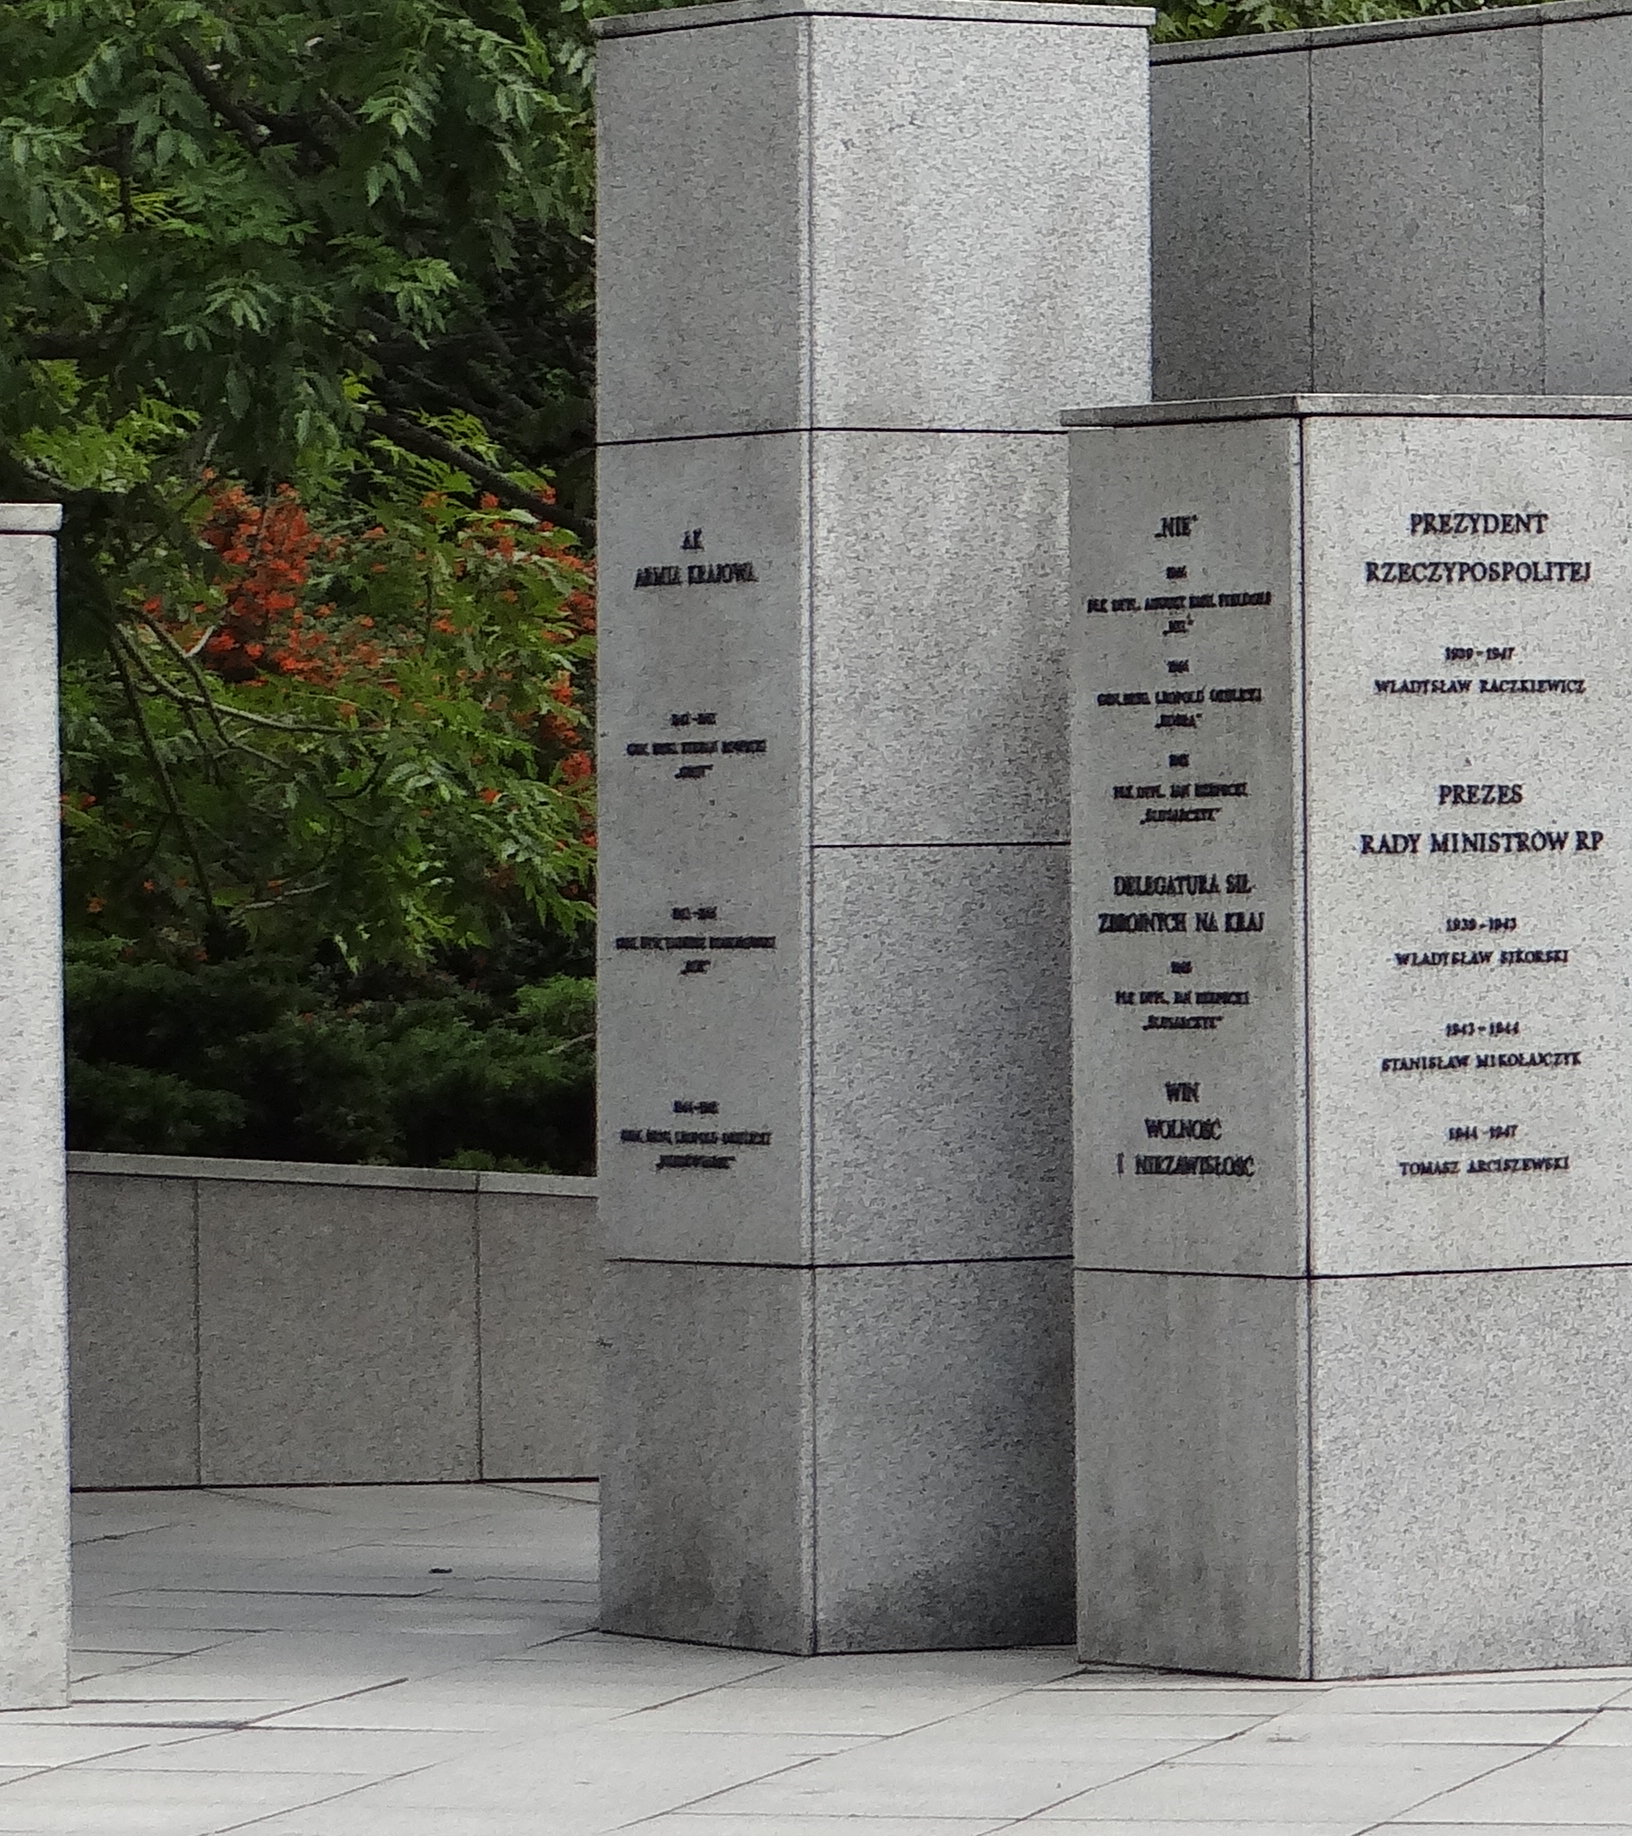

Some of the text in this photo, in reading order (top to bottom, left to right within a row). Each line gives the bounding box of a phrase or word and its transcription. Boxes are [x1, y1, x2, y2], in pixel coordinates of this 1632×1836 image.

[1410, 512, 1549, 536] PREZYDENT
[1365, 560, 1592, 584] RZECZYPOSPOLITEJ
[1373, 677, 1587, 695] WŁADYSŁAW RACZKIEWICZ
[1437, 783, 1524, 806] PREZES
[1359, 828, 1605, 856] RADY MINISTRÓW RP
[1113, 873, 1221, 897] DELEGATURA
[1394, 949, 1494, 966] WŁADYSŁAW
[1380, 1050, 1582, 1072] STANISŁAW MIKOŁAJCZYK
[1164, 1081, 1201, 1103] WIN
[1399, 1159, 1461, 1176] TOMASZ
